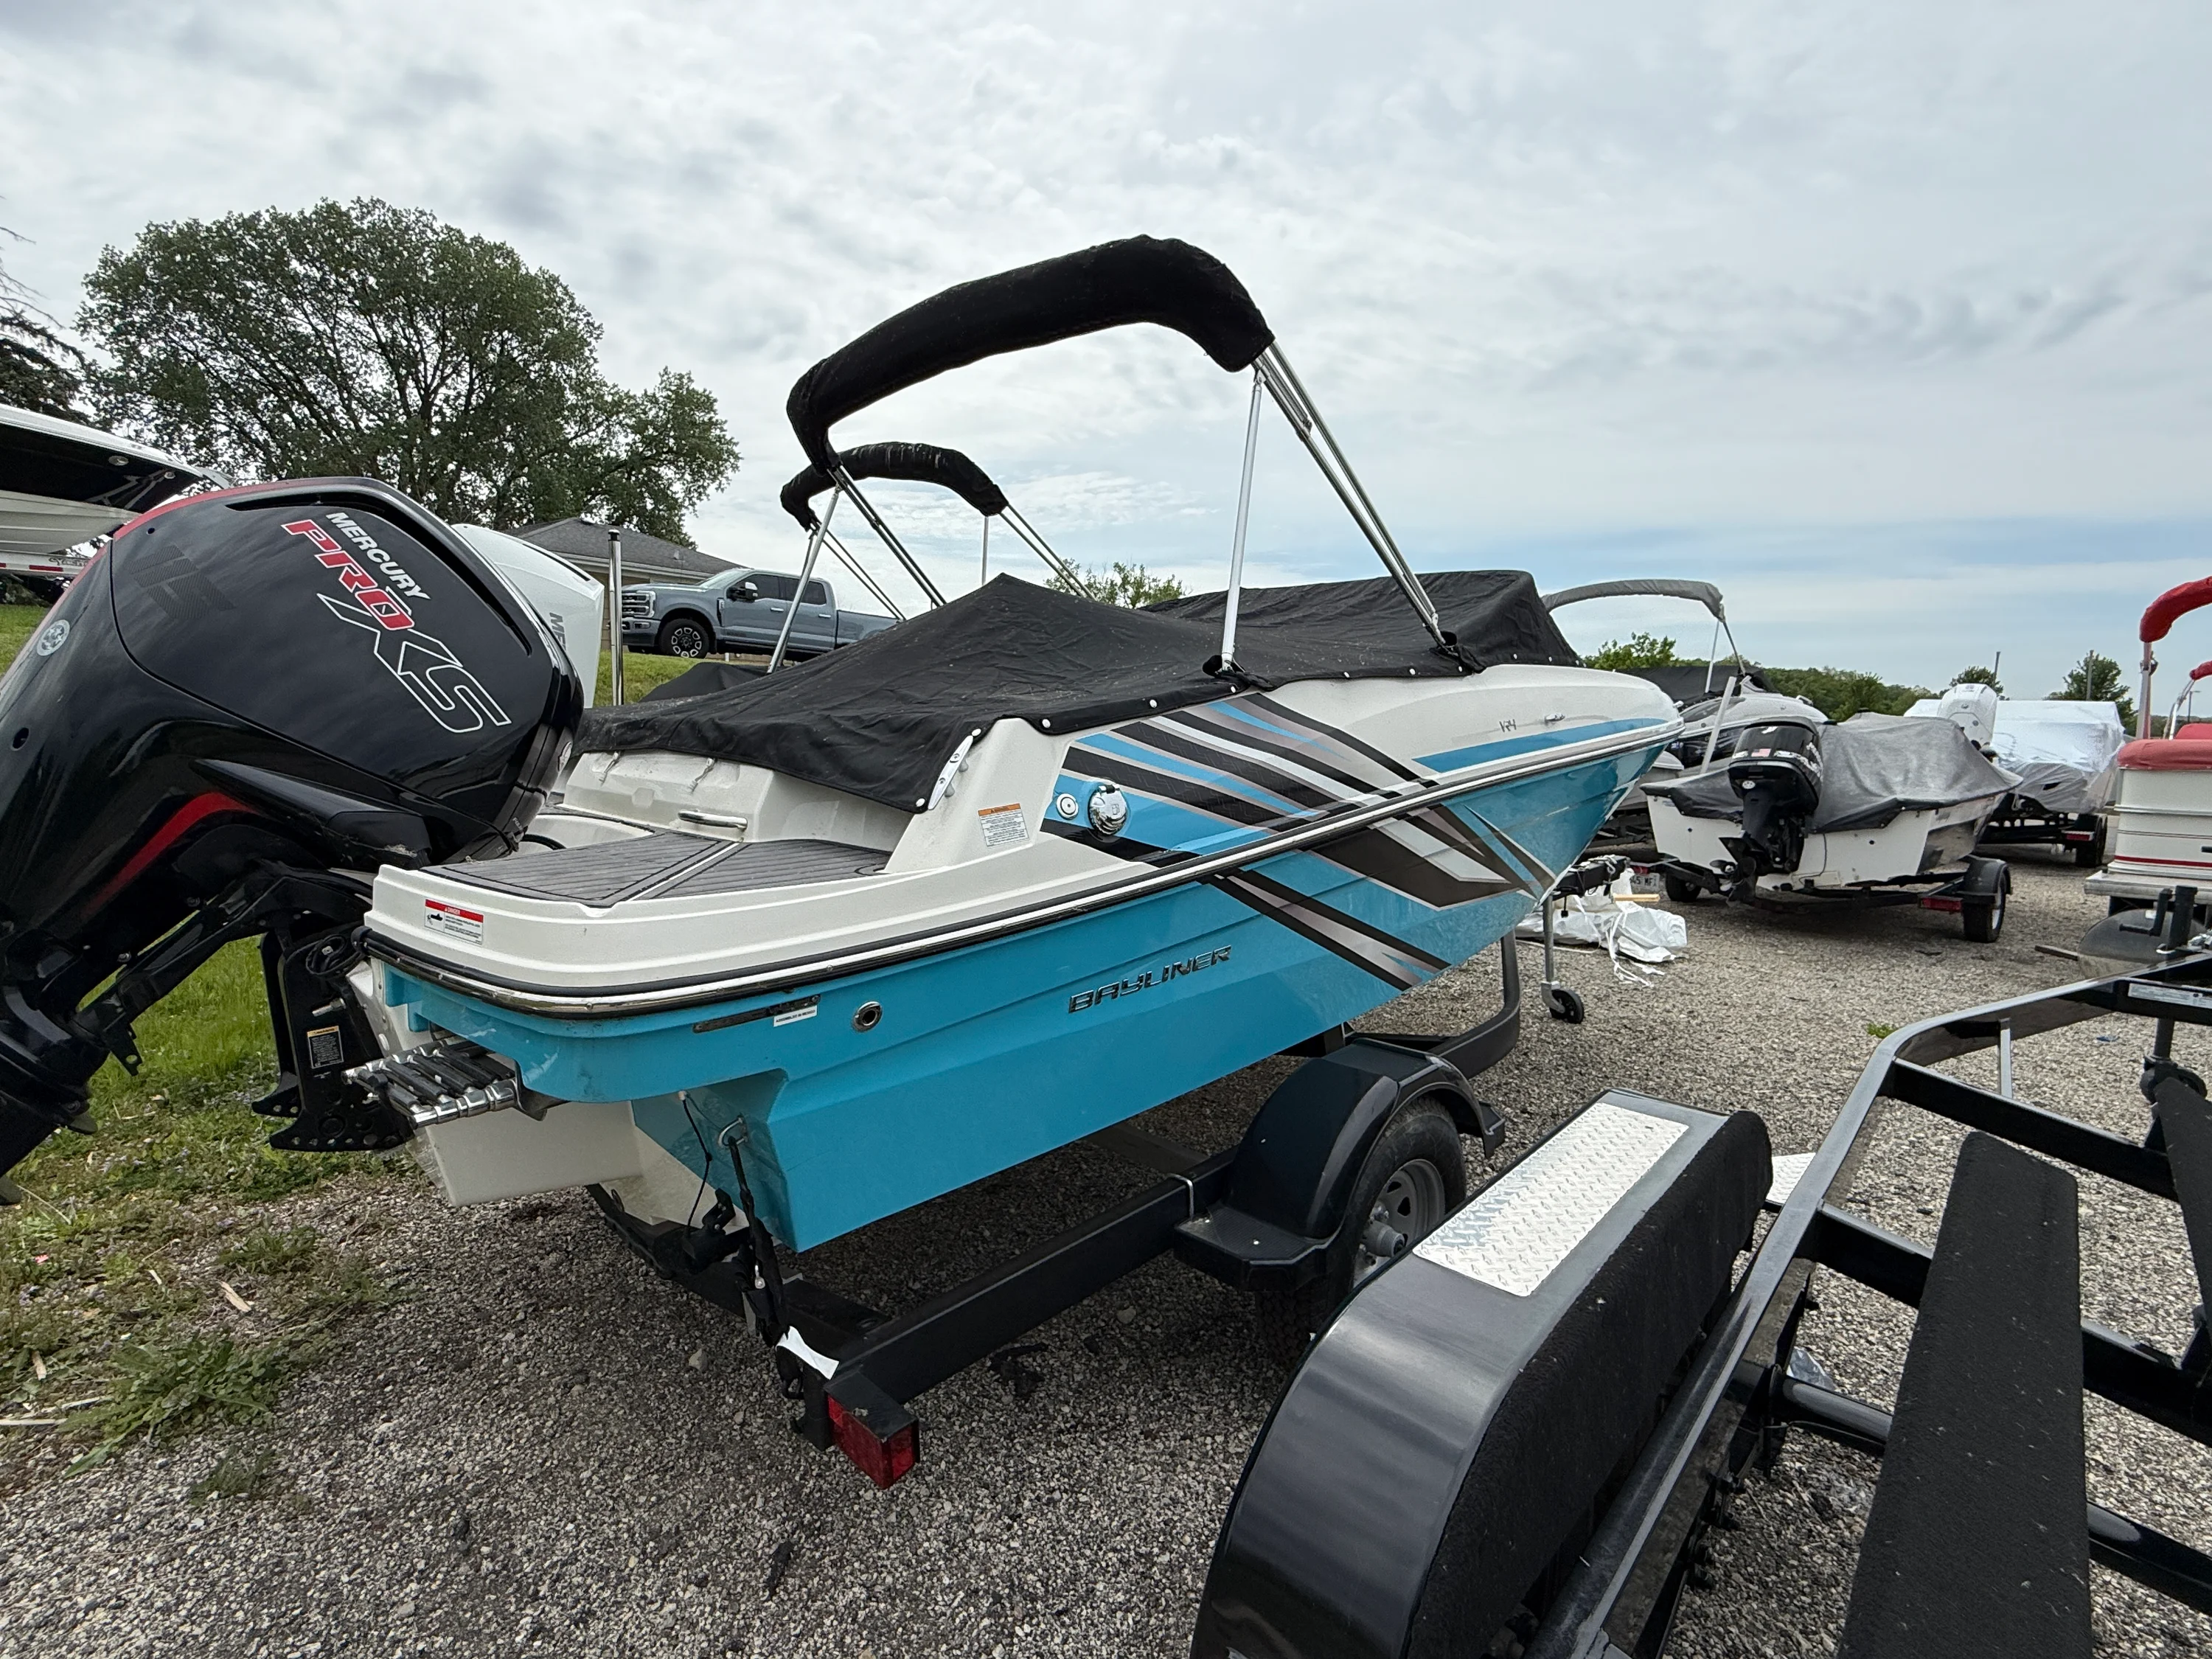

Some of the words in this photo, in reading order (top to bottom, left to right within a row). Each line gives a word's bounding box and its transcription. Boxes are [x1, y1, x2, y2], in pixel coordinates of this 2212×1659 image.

[281, 519, 415, 630] PRO
[325, 512, 431, 600] MERCURY
[316, 586, 512, 733] XS
[549, 612, 566, 651] ME
[1068, 945, 1232, 1013] BAYLINER
